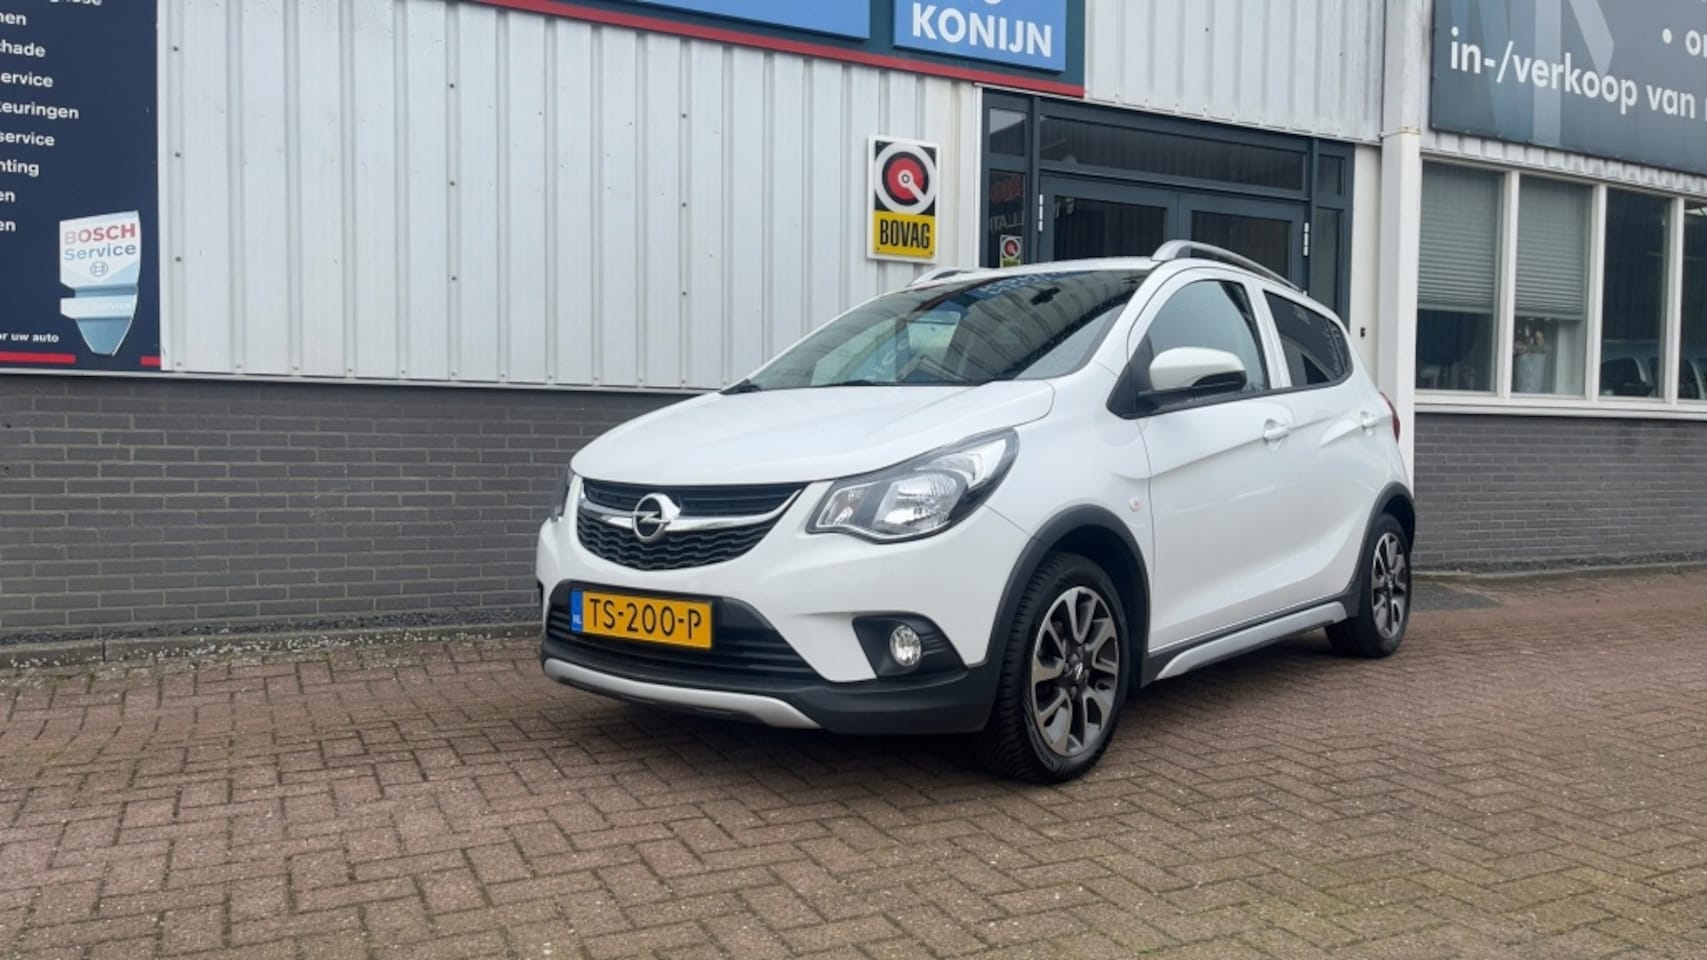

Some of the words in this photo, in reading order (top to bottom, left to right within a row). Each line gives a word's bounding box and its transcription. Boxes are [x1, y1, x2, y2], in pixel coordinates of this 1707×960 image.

[913, 2, 1052, 58] KONIJN
[1451, 26, 1637, 115] in-/verkoop
[1646, 84, 1695, 119] van
[0, 101, 80, 120] euringen
[65, 223, 136, 245] BOSCH
[879, 218, 930, 249] BOVAG
[64, 243, 137, 261] Service
[0, 332, 9, 341] r
[11, 333, 29, 342] uw
[32, 333, 60, 343] auto
[590, 598, 702, 640] TS-200-P
